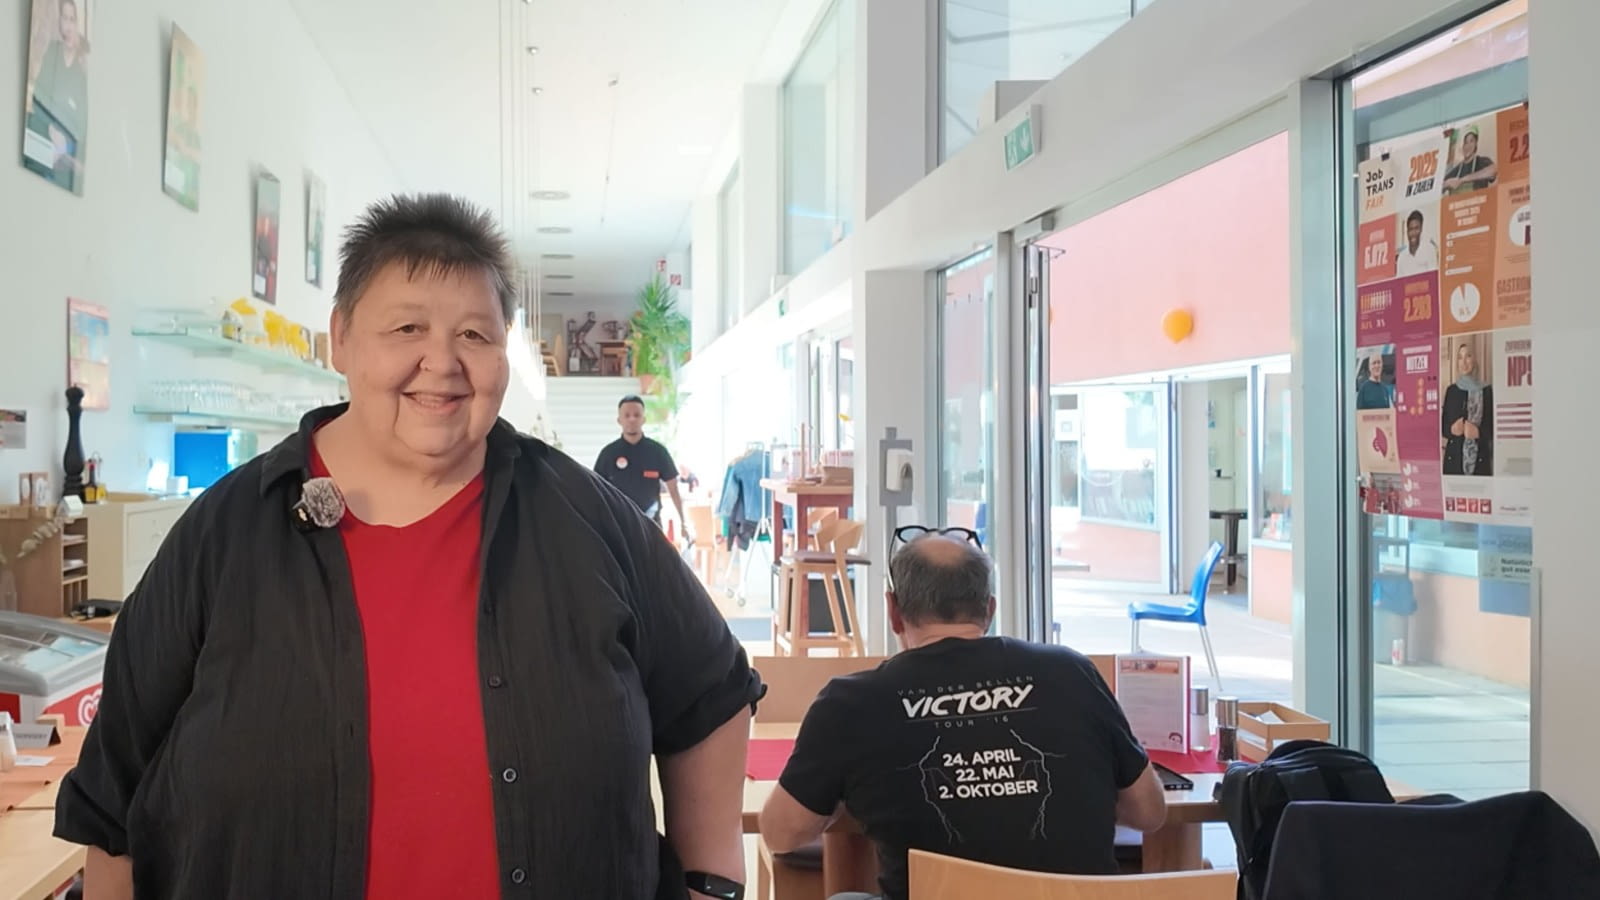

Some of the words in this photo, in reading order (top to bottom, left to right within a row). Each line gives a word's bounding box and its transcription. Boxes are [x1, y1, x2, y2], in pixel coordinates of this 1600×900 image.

[1408, 149, 1439, 183] 2025
[1366, 169, 1383, 183] Job
[1366, 177, 1394, 197] TRANS
[1405, 184, 1413, 198] IN
[1366, 195, 1384, 211] FAIR
[898, 689, 926, 697] VAN
[937, 684, 965, 693] DER
[976, 675, 1034, 689] BELLEN
[902, 684, 1034, 718] VICTORY
[935, 720, 974, 728] TOUR
[942, 753, 968, 767] 24.
[972, 748, 1021, 765] APRIL
[955, 769, 980, 782] 22.
[983, 765, 1015, 780] MAI
[938, 786, 954, 799] 2.
[956, 780, 1039, 798] OKTOBER
